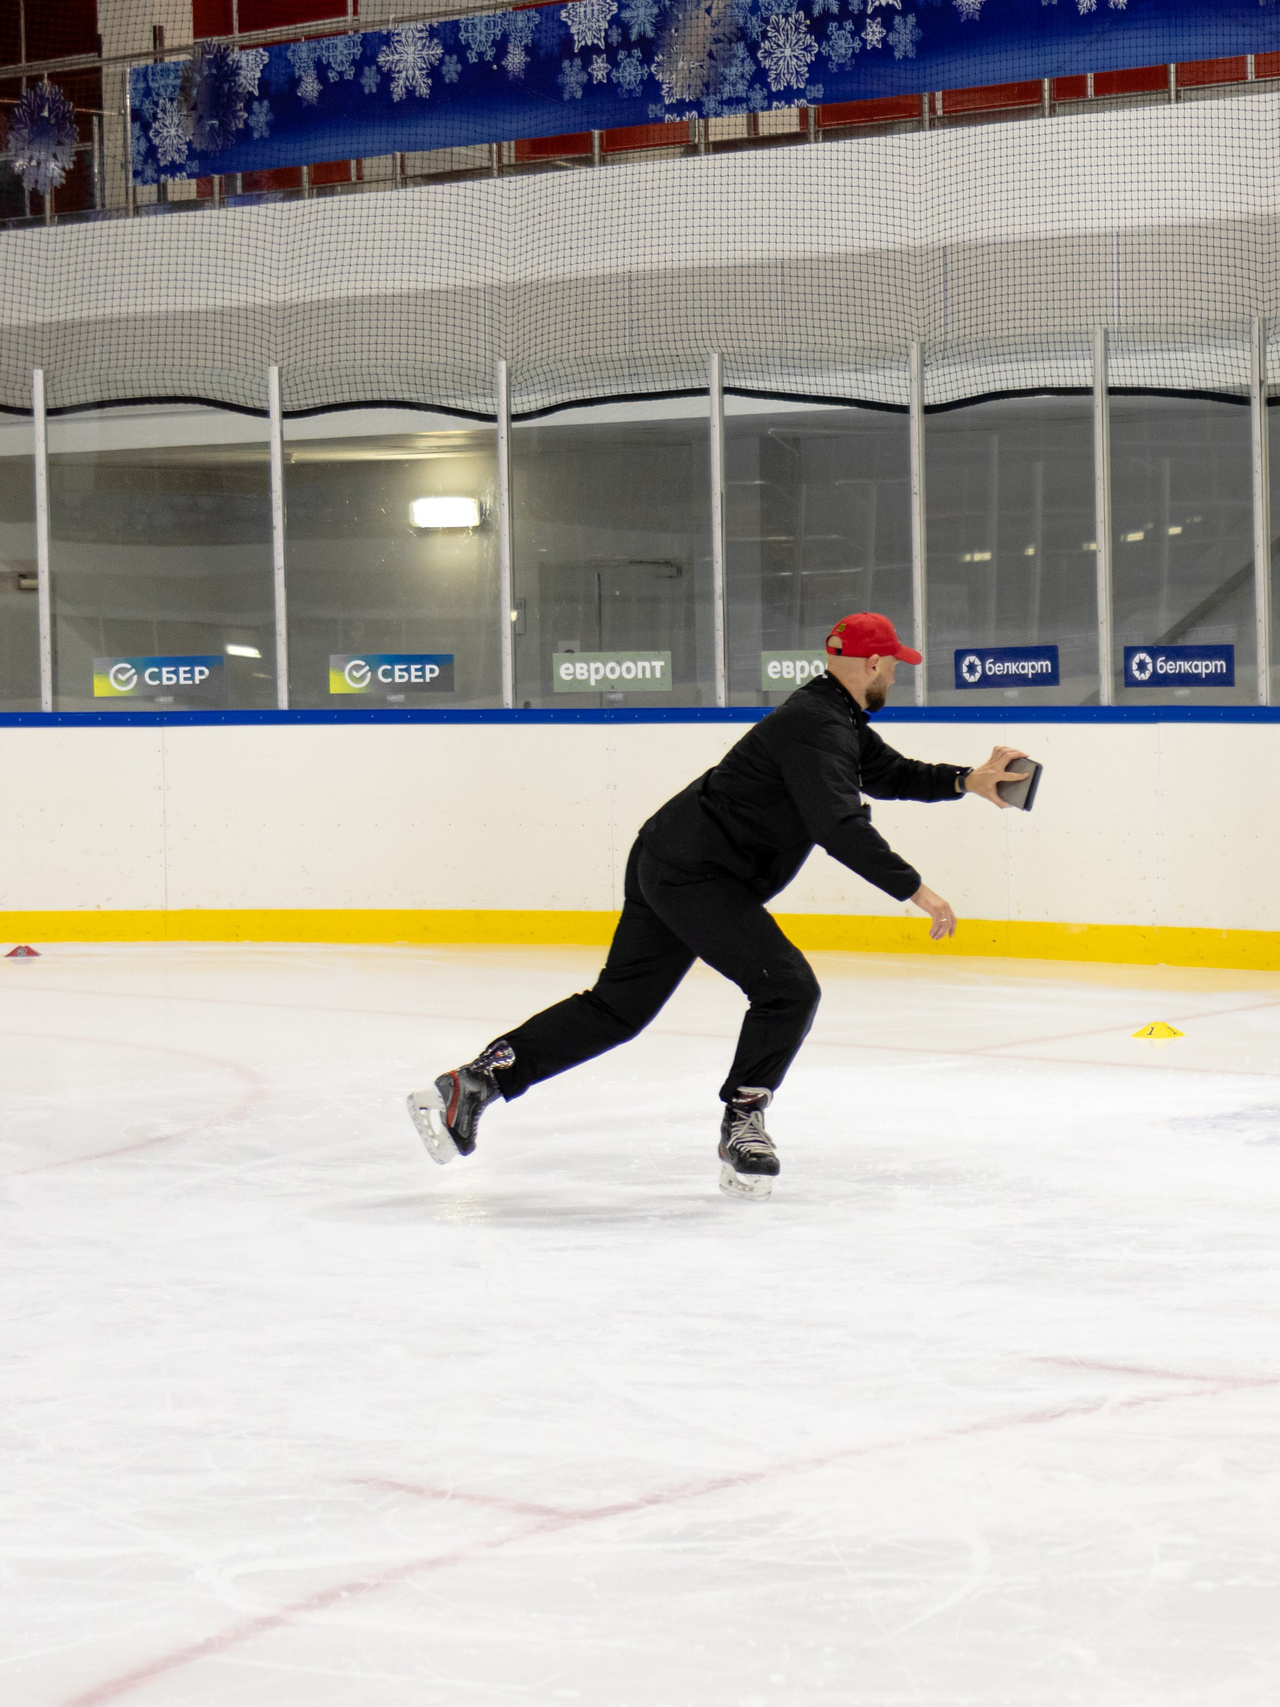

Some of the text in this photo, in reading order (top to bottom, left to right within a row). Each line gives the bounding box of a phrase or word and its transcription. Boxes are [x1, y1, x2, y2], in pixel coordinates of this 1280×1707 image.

[144, 666, 210, 686] СБЕР
[377, 664, 441, 684] СБЕР
[559, 660, 666, 686] евроопт
[767, 659, 828, 685] евро
[985, 658, 1052, 678] белкарт
[1156, 657, 1227, 678] белкарт
